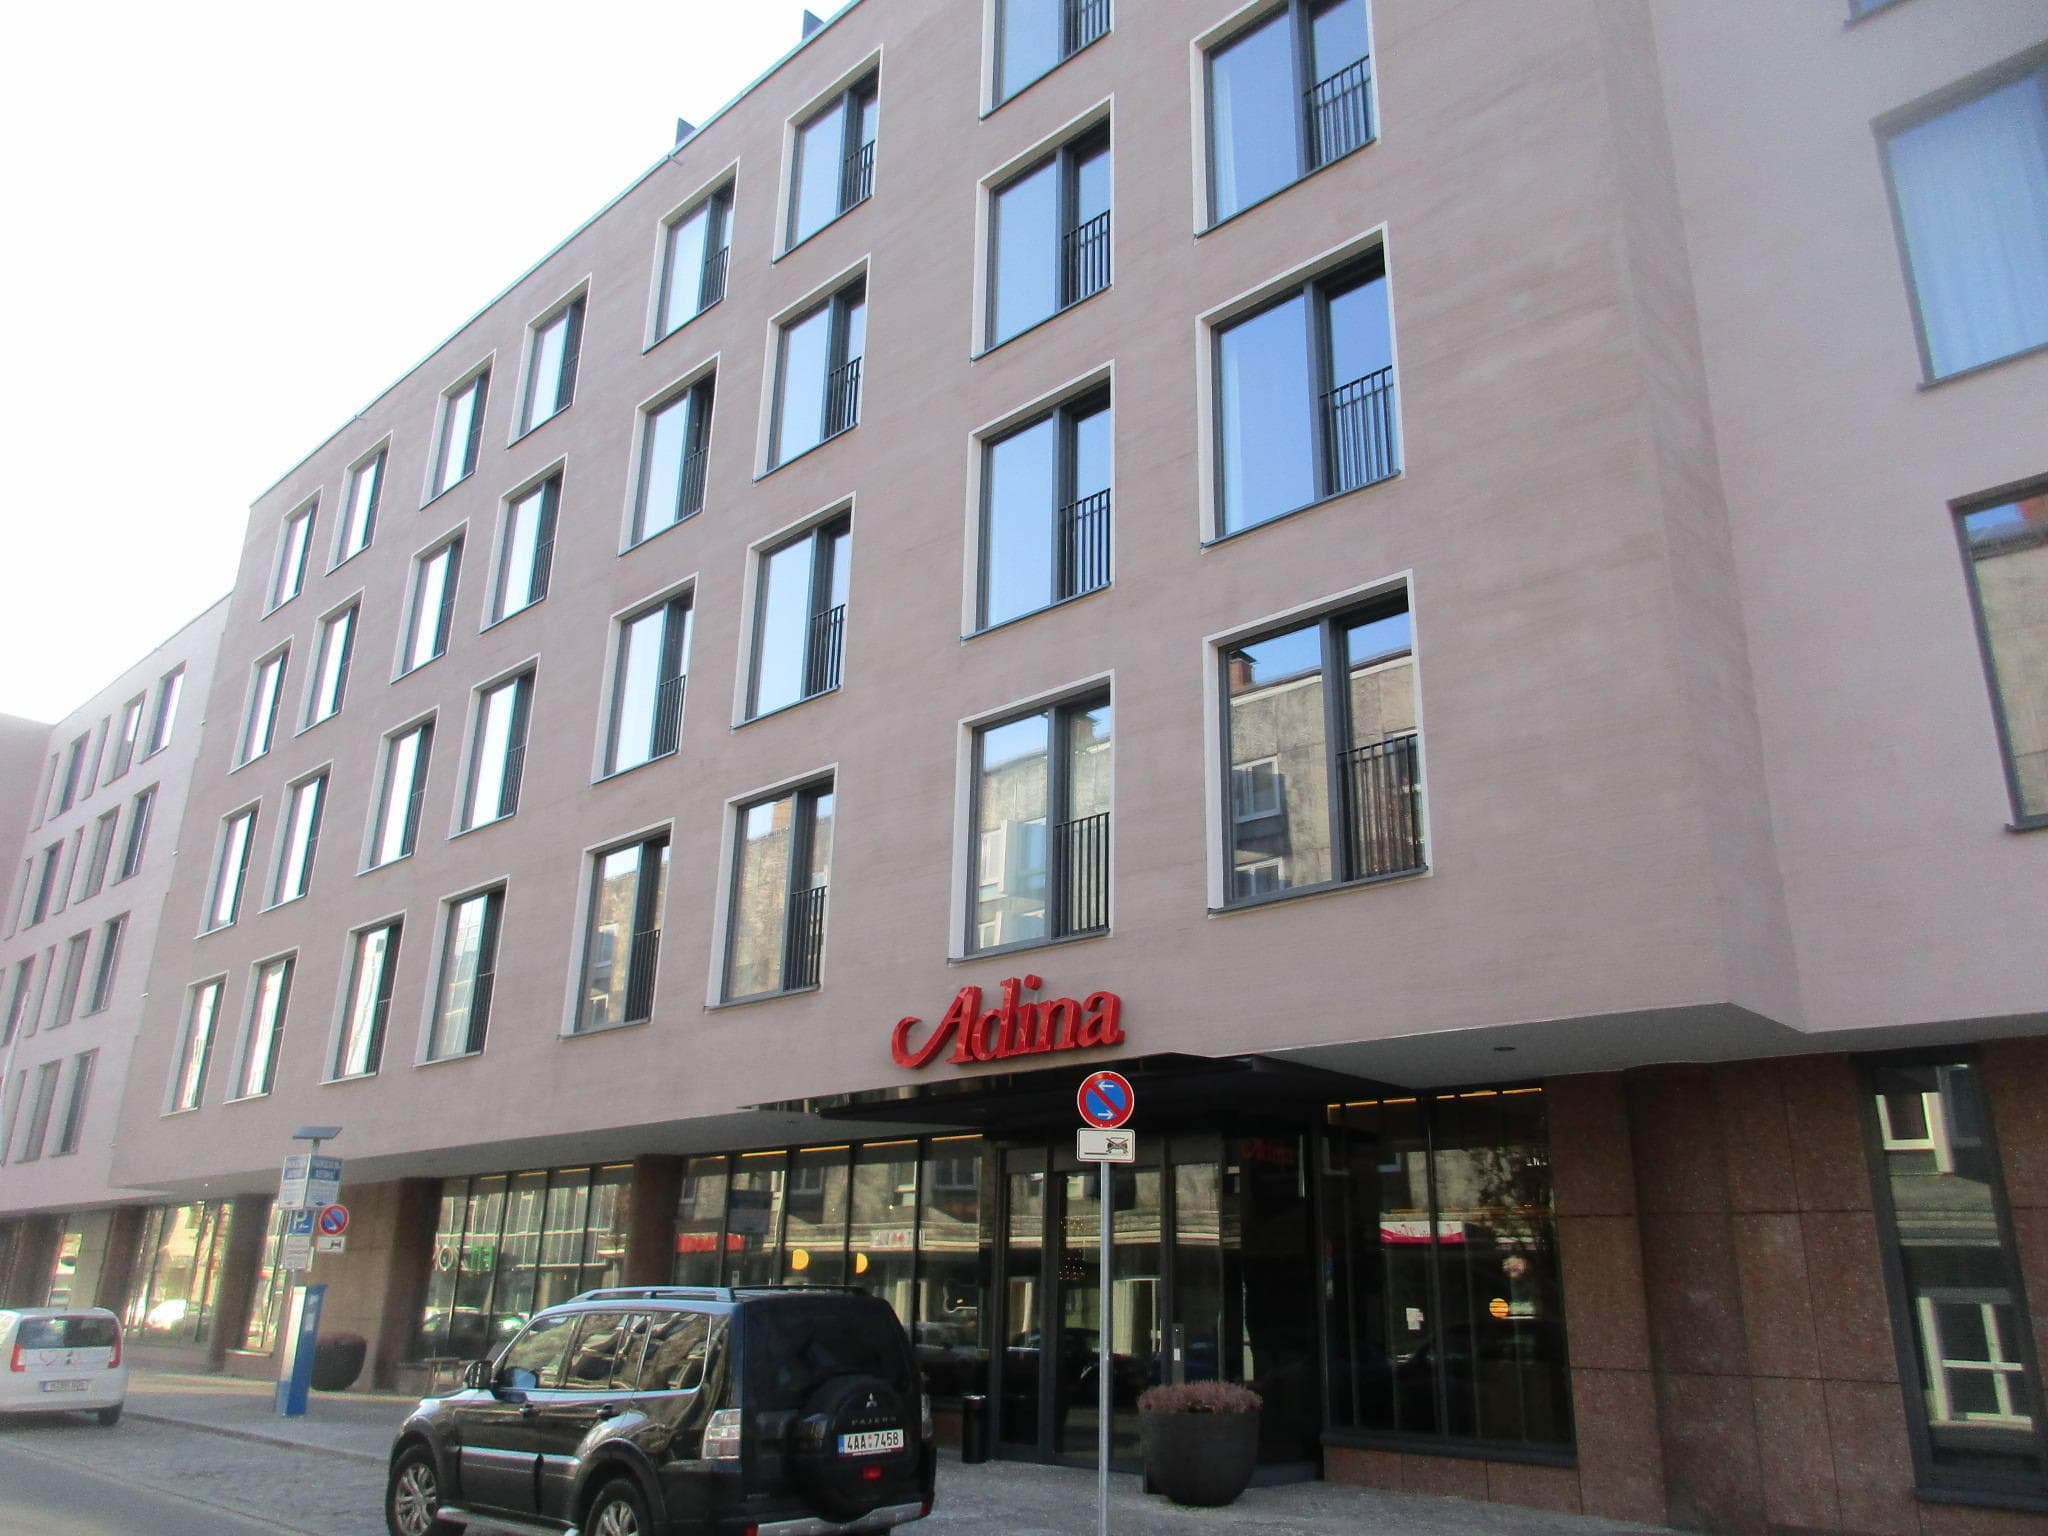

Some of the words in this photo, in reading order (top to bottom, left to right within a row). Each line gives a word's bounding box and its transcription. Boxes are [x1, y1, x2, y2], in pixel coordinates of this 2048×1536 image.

[891, 974, 1125, 1069] Adina
[847, 1434, 866, 1450] 4AA
[874, 1432, 899, 1448] 7458
